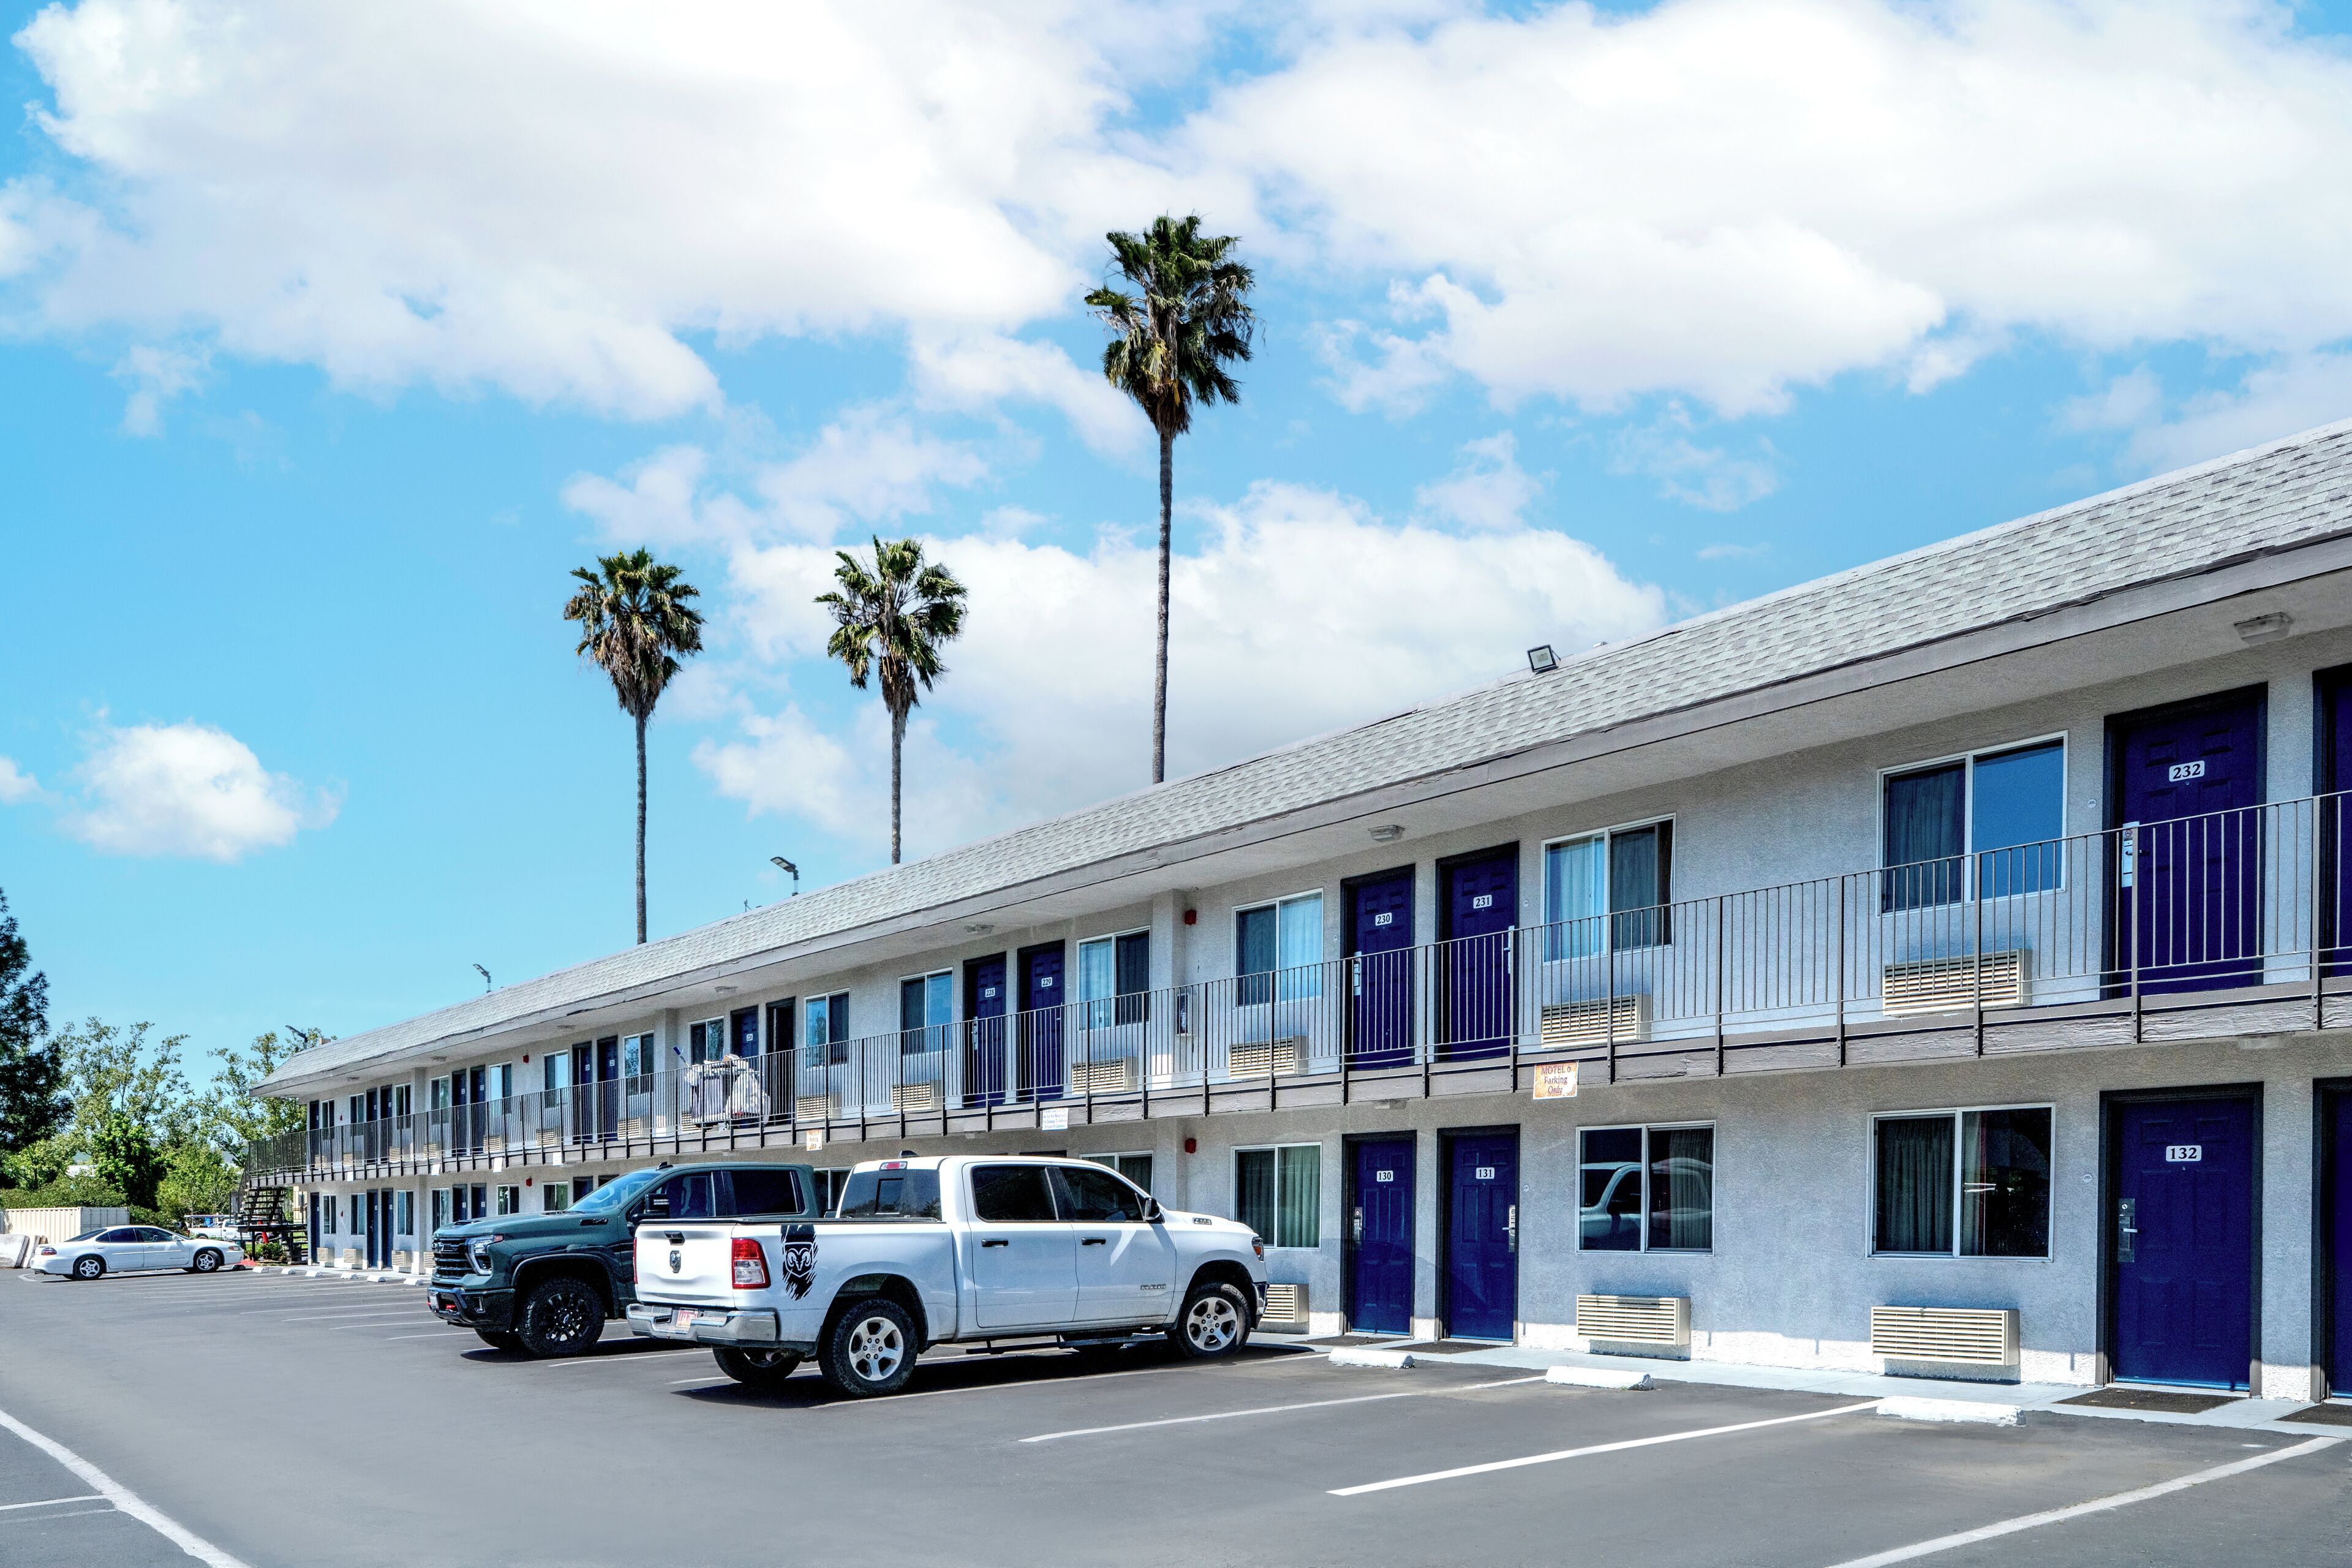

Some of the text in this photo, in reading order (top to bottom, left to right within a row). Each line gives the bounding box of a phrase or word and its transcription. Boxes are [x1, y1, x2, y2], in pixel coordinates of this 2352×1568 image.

[2173, 763, 2201, 780] 232
[1476, 896, 1490, 907] 231
[1377, 914, 1390, 924] 230
[1541, 1066, 1566, 1075] MOTEL
[1544, 1076, 1568, 1085] Parking
[1548, 1085, 1563, 1095] Only
[2170, 1147, 2198, 1159] 132
[1378, 1172, 1392, 1180] 130
[1478, 1169, 1493, 1178] 131
